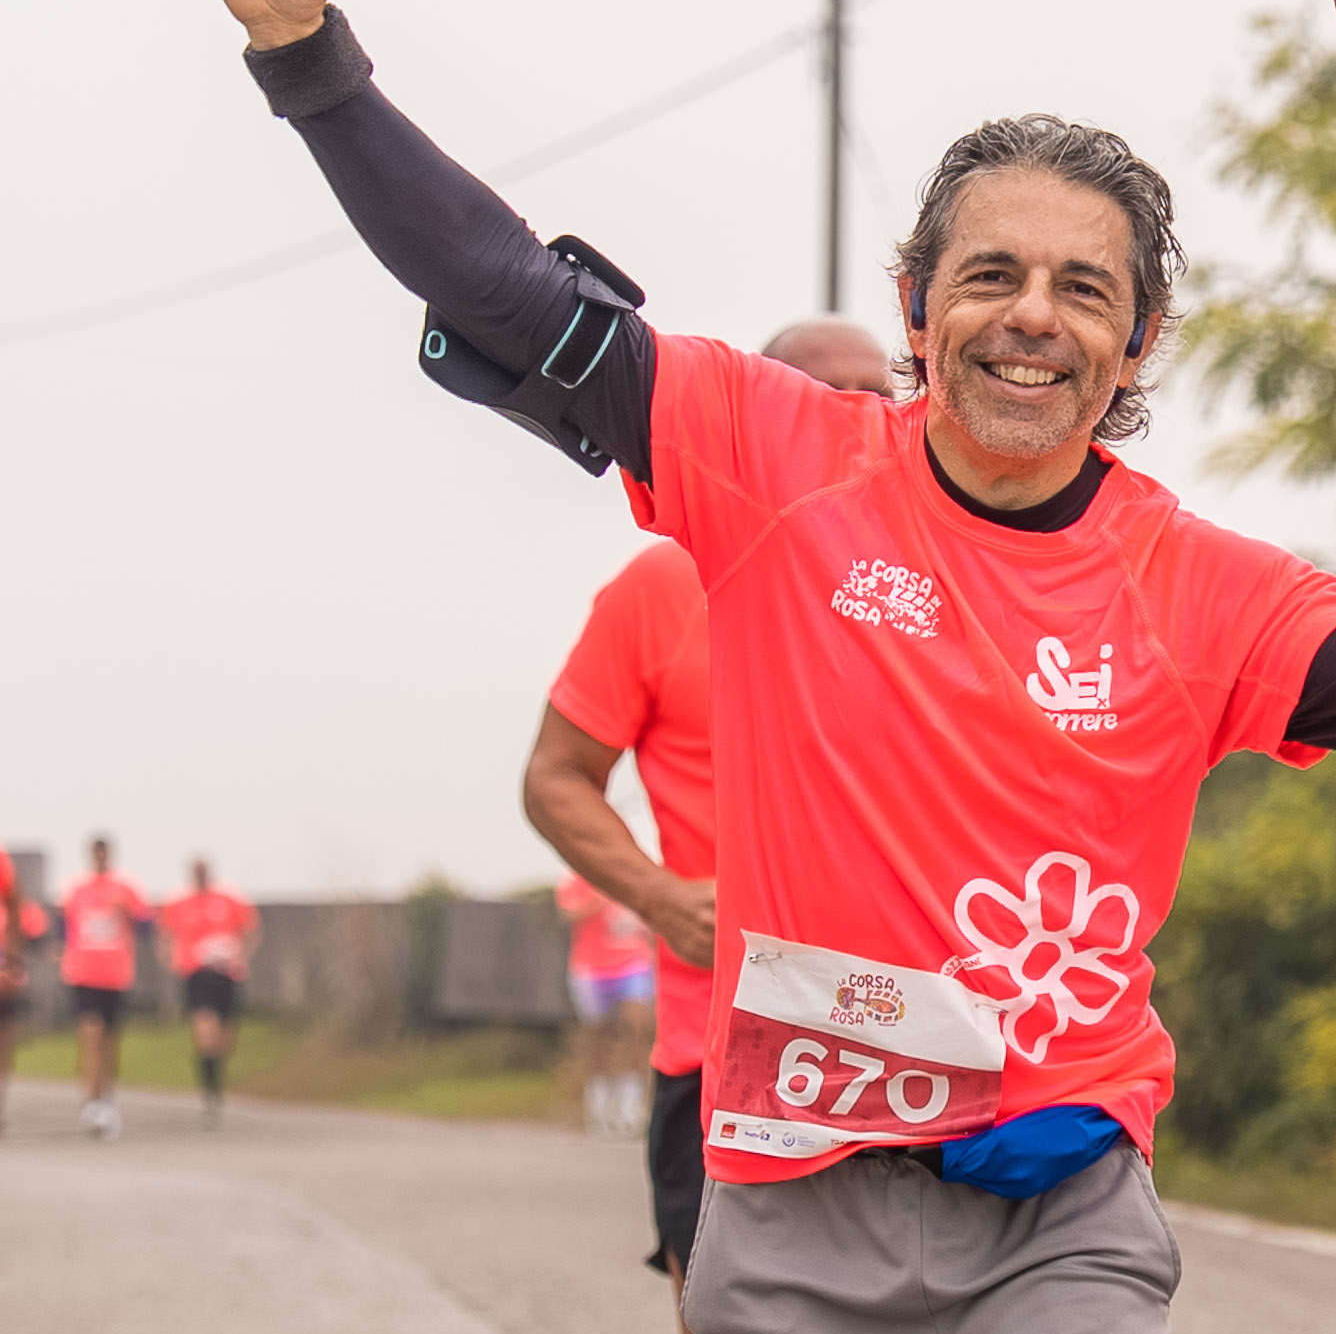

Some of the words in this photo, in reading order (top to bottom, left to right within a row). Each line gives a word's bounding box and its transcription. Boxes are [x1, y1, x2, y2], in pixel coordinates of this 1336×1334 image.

[871, 558, 932, 598] CORSA
[831, 589, 881, 627] ROSA
[1044, 712, 1118, 731] orrere
[849, 973, 895, 992] CORSA
[829, 1006, 865, 1025] ROSA
[775, 1038, 950, 1124] 670
